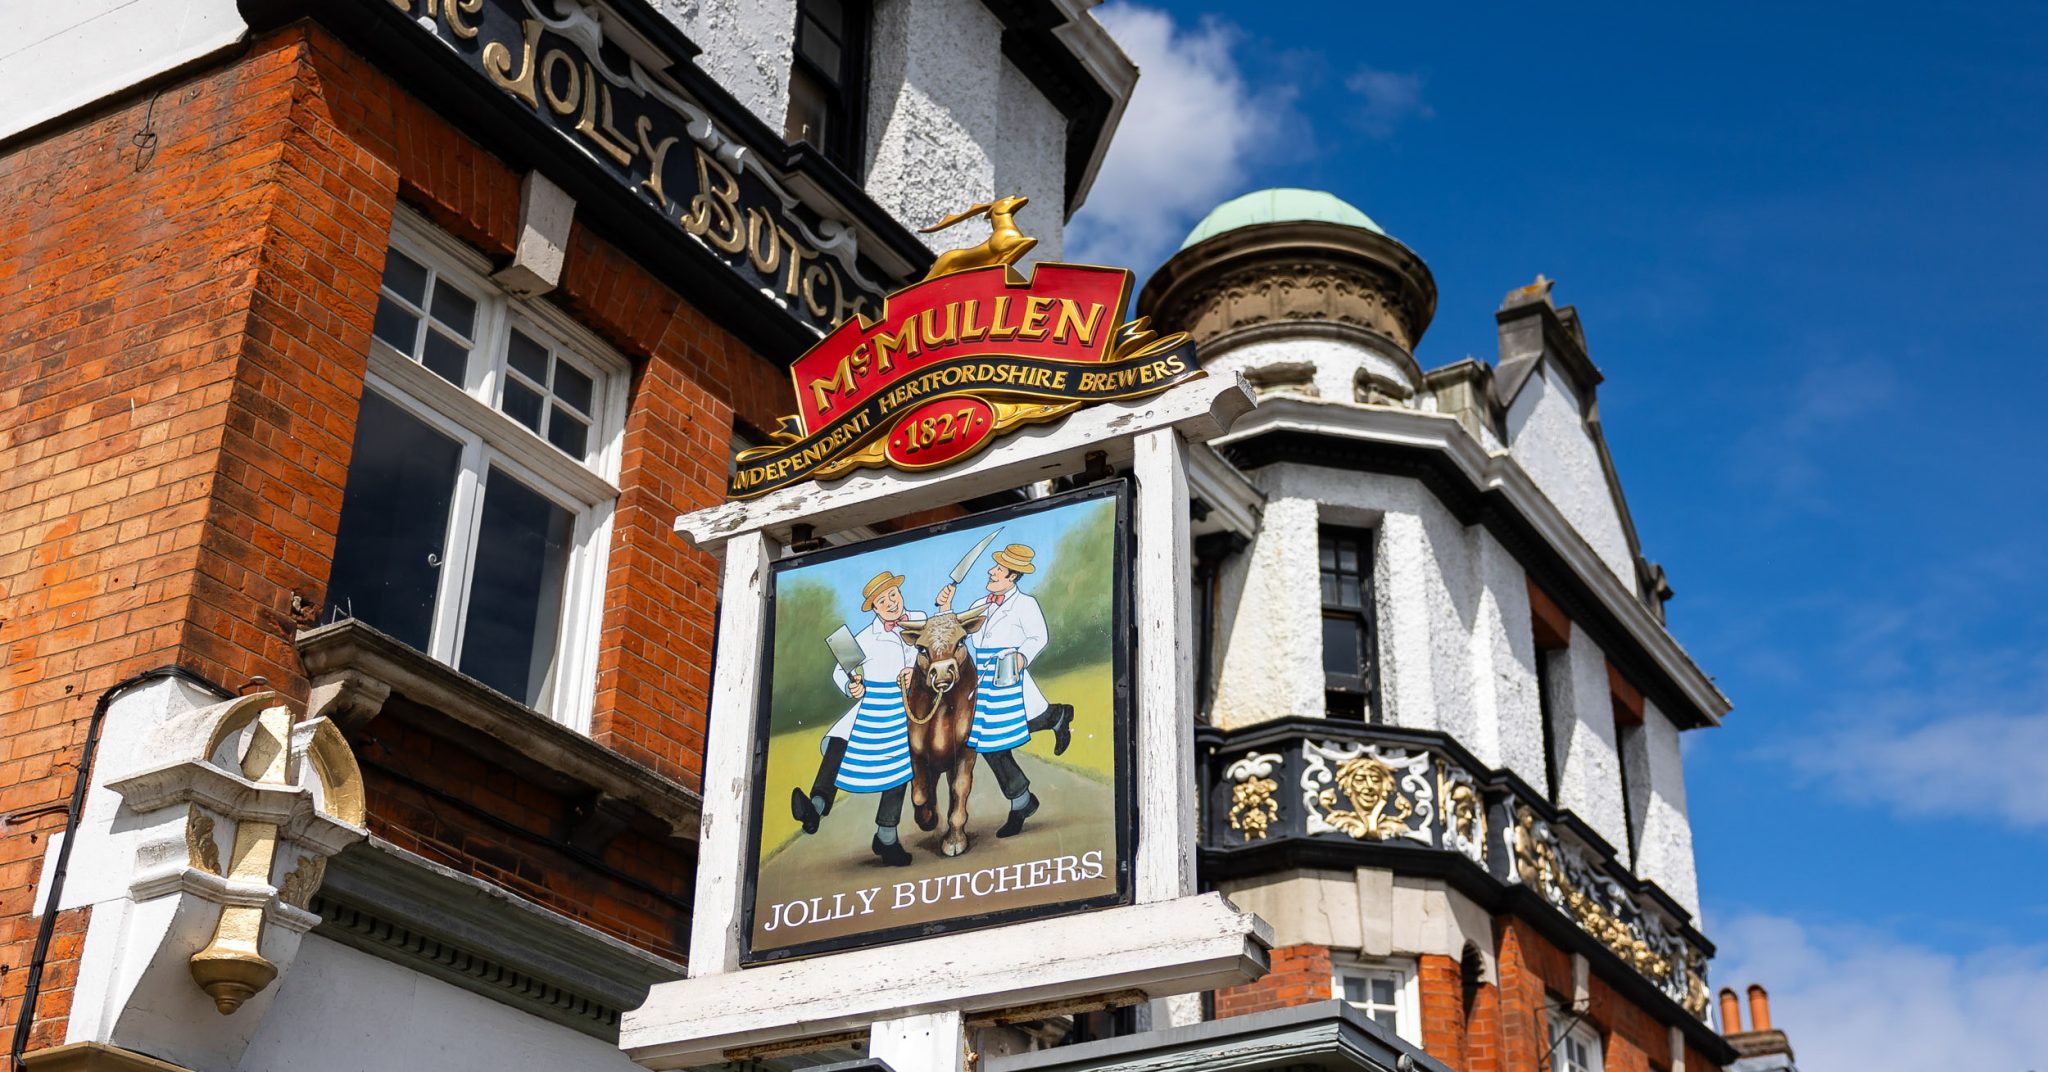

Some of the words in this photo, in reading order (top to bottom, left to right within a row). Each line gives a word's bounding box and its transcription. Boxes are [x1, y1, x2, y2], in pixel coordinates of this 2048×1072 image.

[482, 19, 680, 206] JOLLY
[680, 147, 883, 327] BUTCH
[733, 408, 870, 490] INDEPENDENT
[879, 363, 1067, 415] HERTFORDSHIRE
[1078, 354, 1186, 393] BREWERS
[763, 887, 882, 932] JOLLY
[891, 850, 1104, 909] BUTCHERS
